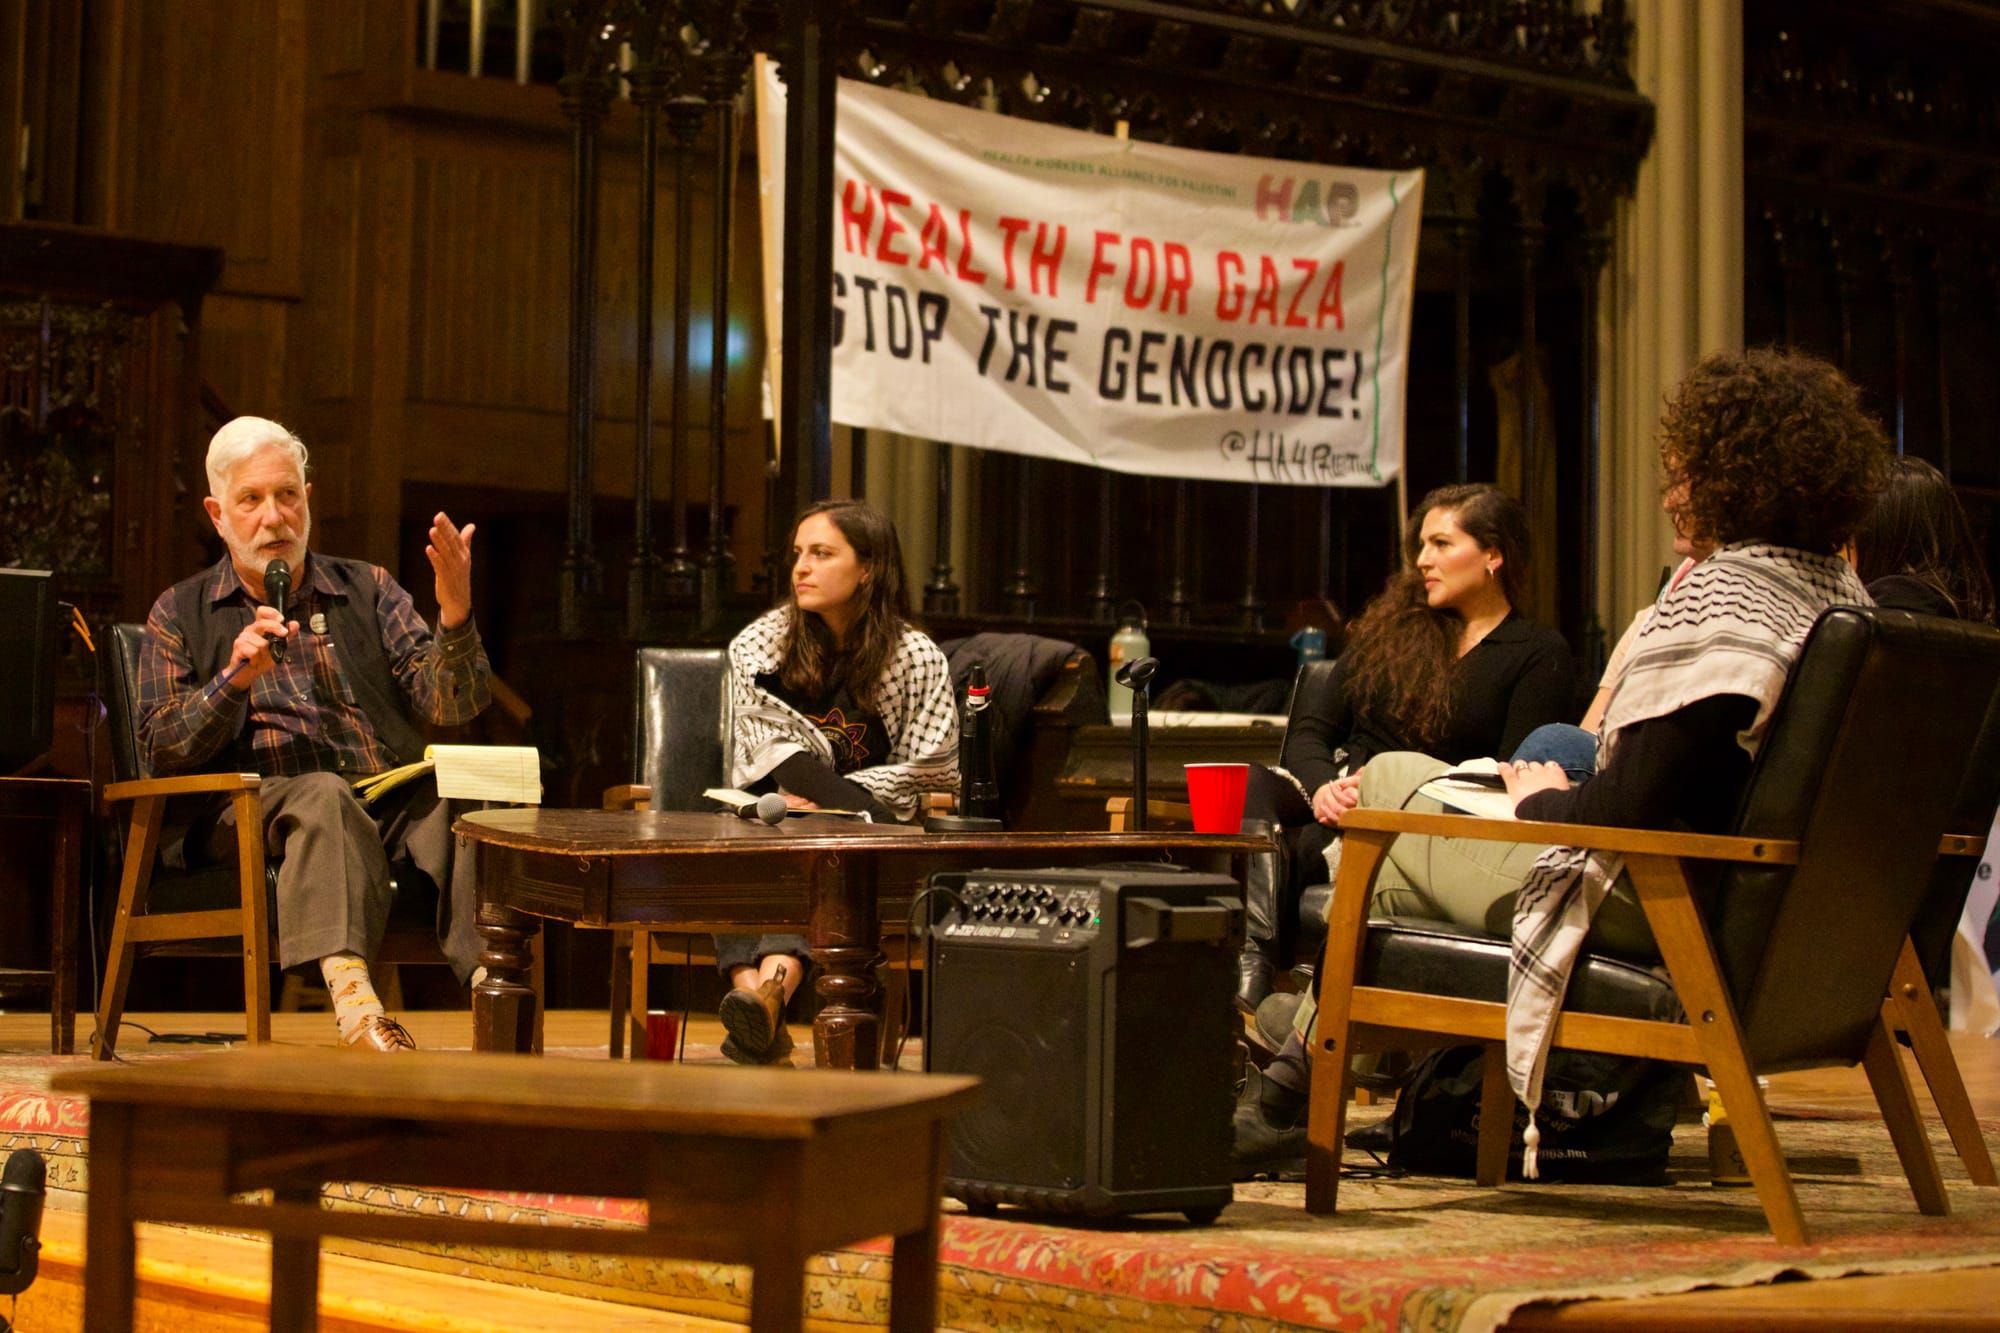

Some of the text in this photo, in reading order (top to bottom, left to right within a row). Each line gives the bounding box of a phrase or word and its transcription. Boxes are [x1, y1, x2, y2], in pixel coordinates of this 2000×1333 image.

[983, 149, 1237, 198] HEALTH WORKERS ALLIANCE FOR PALESTINE
[840, 179, 1345, 332] HEALTH FOR GAZA
[977, 305, 1077, 394] THE
[1098, 326, 1363, 420] GENOCIDE!
